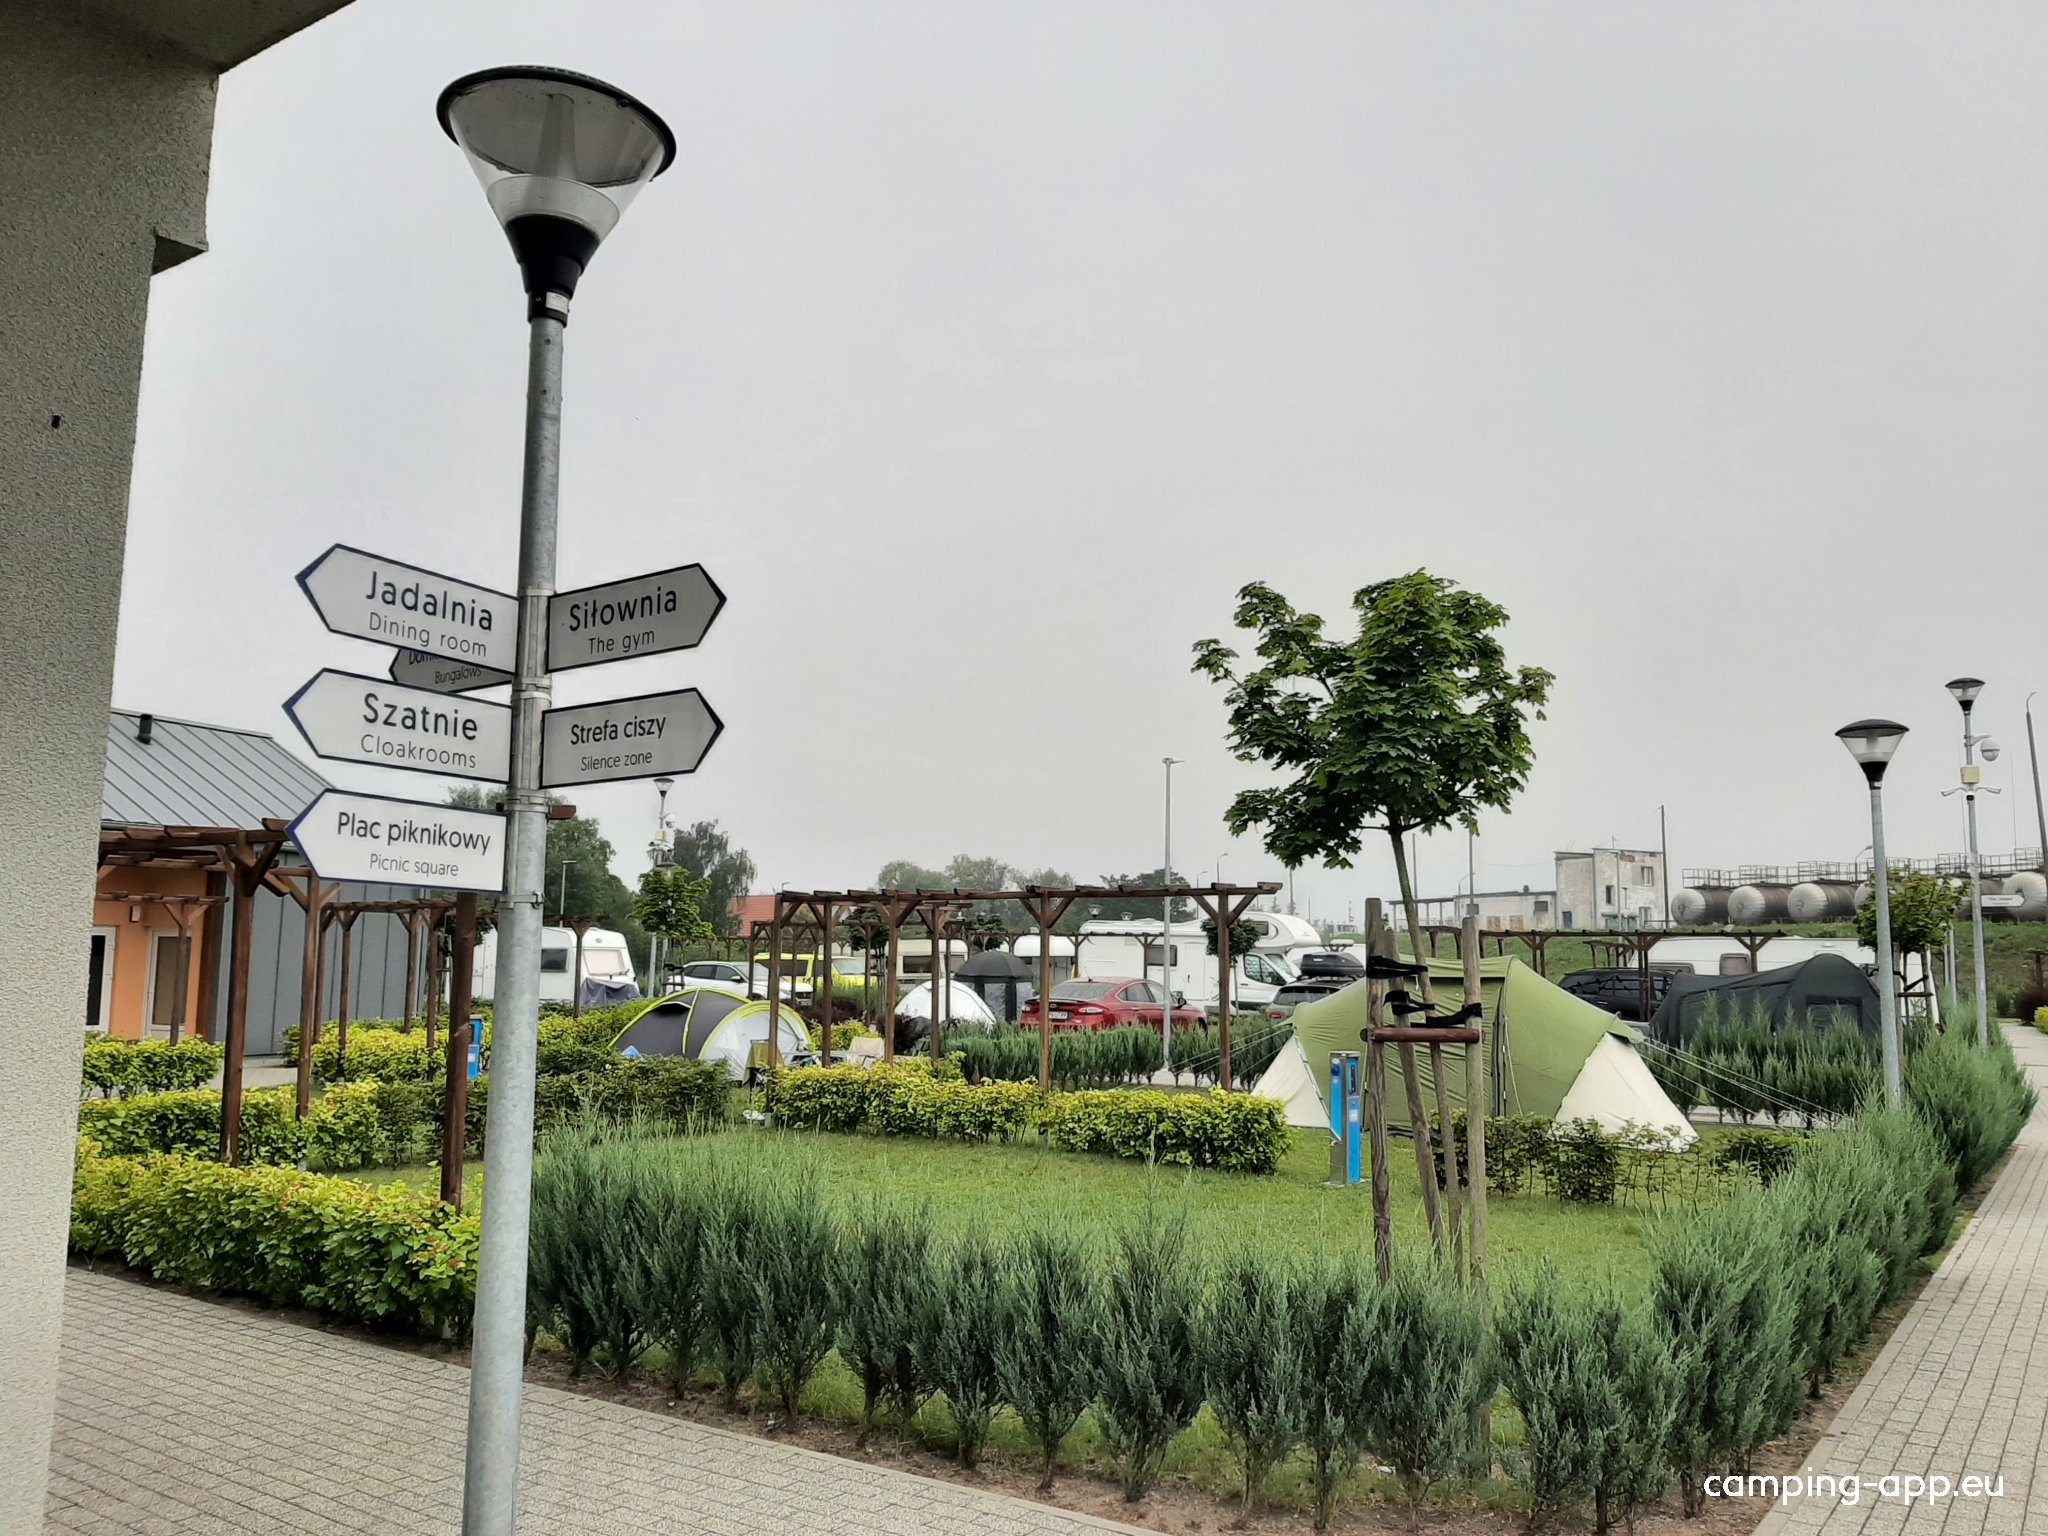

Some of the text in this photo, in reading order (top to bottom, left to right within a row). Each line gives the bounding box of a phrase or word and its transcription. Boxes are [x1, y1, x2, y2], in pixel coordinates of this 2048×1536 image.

[365, 570, 493, 632] Jadalnia
[568, 586, 677, 632] Siłownia
[368, 611, 487, 658] Dining room
[588, 630, 655, 655] The gym
[434, 667, 482, 685] Bungalows
[362, 692, 478, 741] Szatnie
[570, 715, 667, 746] Strefa ciszy
[360, 734, 477, 769] Cloakrooms
[580, 751, 653, 772] Silence zone
[337, 811, 491, 857] Plac piknikowy
[369, 853, 459, 878] Picnic square
